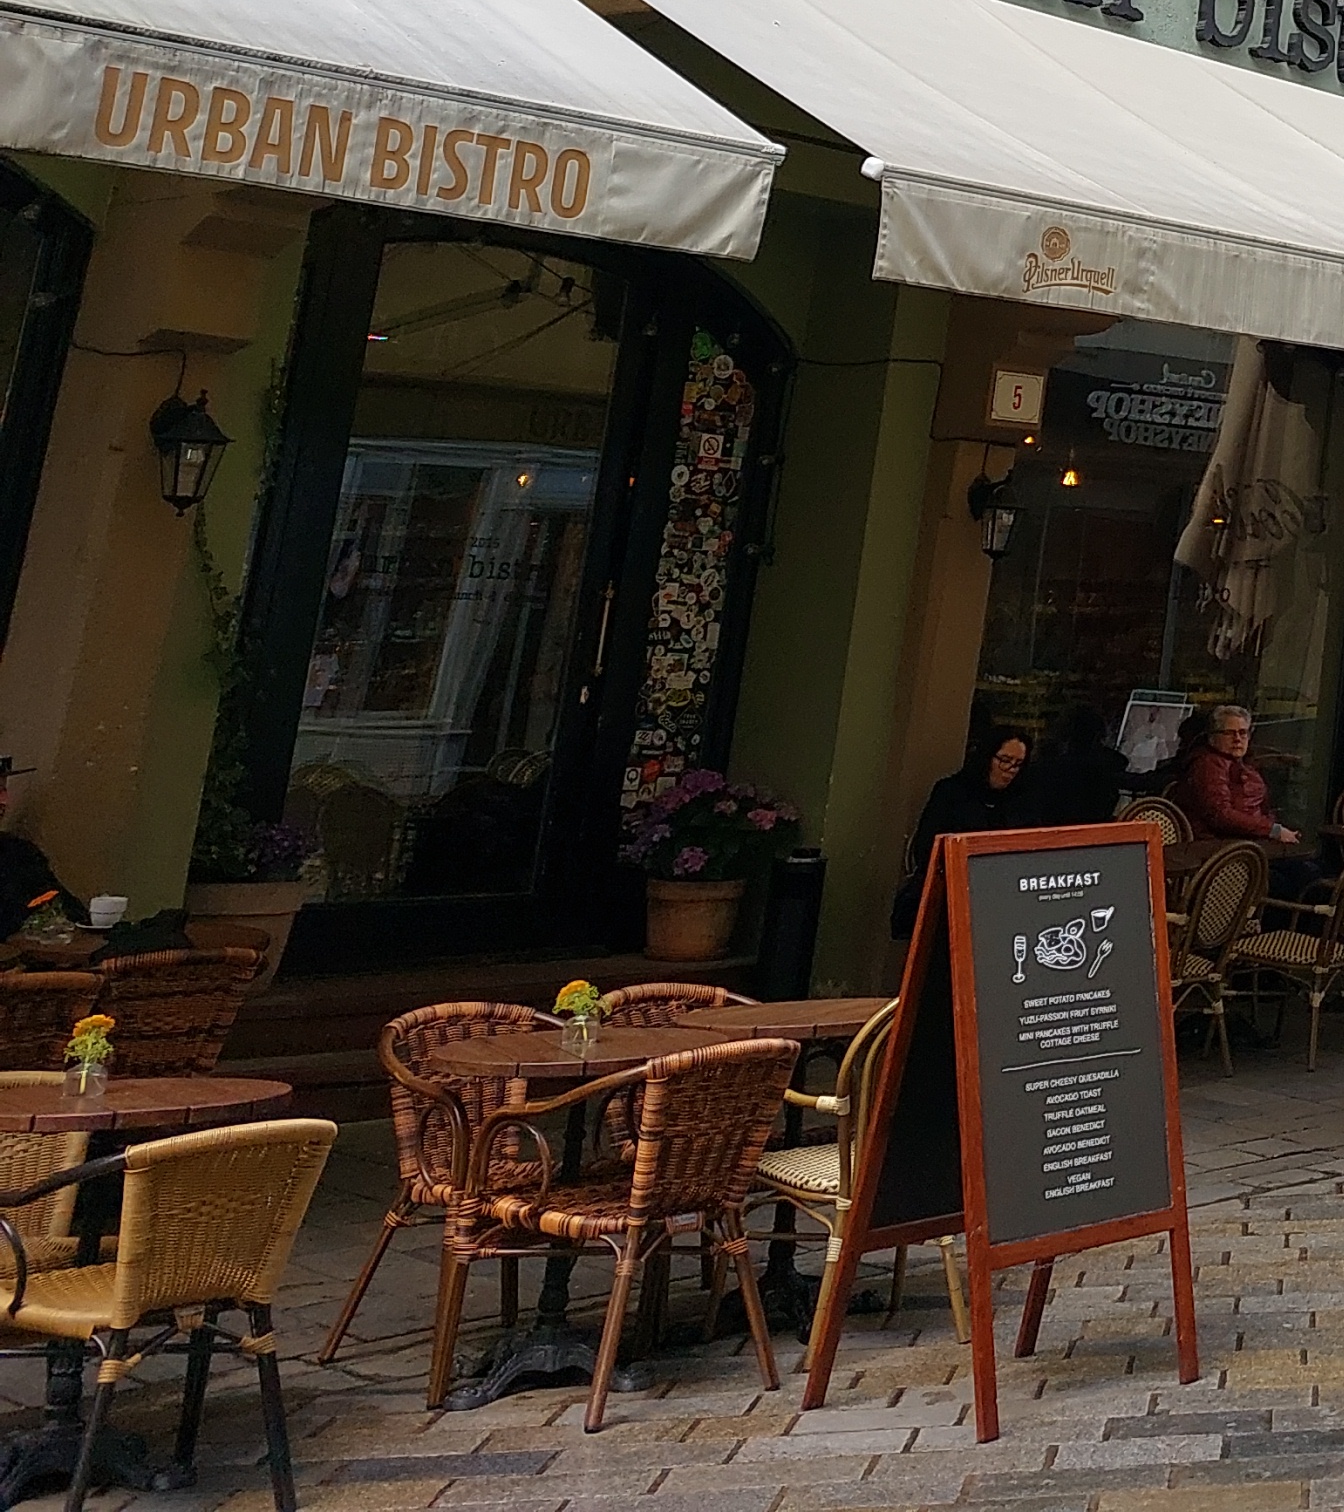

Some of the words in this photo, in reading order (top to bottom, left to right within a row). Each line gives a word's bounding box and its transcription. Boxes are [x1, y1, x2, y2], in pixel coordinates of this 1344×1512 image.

[95, 66, 352, 183] URBAN
[370, 115, 592, 219] BISTRO
[1022, 253, 1071, 293] Pilsner
[1071, 257, 1115, 293] Urquell
[1012, 385, 1023, 411] 5
[1019, 872, 1100, 892] BREAKFAST
[1043, 1142, 1076, 1155] AVOCADO
[1073, 1150, 1113, 1166] BREAKFAST
[1067, 1172, 1091, 1184] VEGAN
